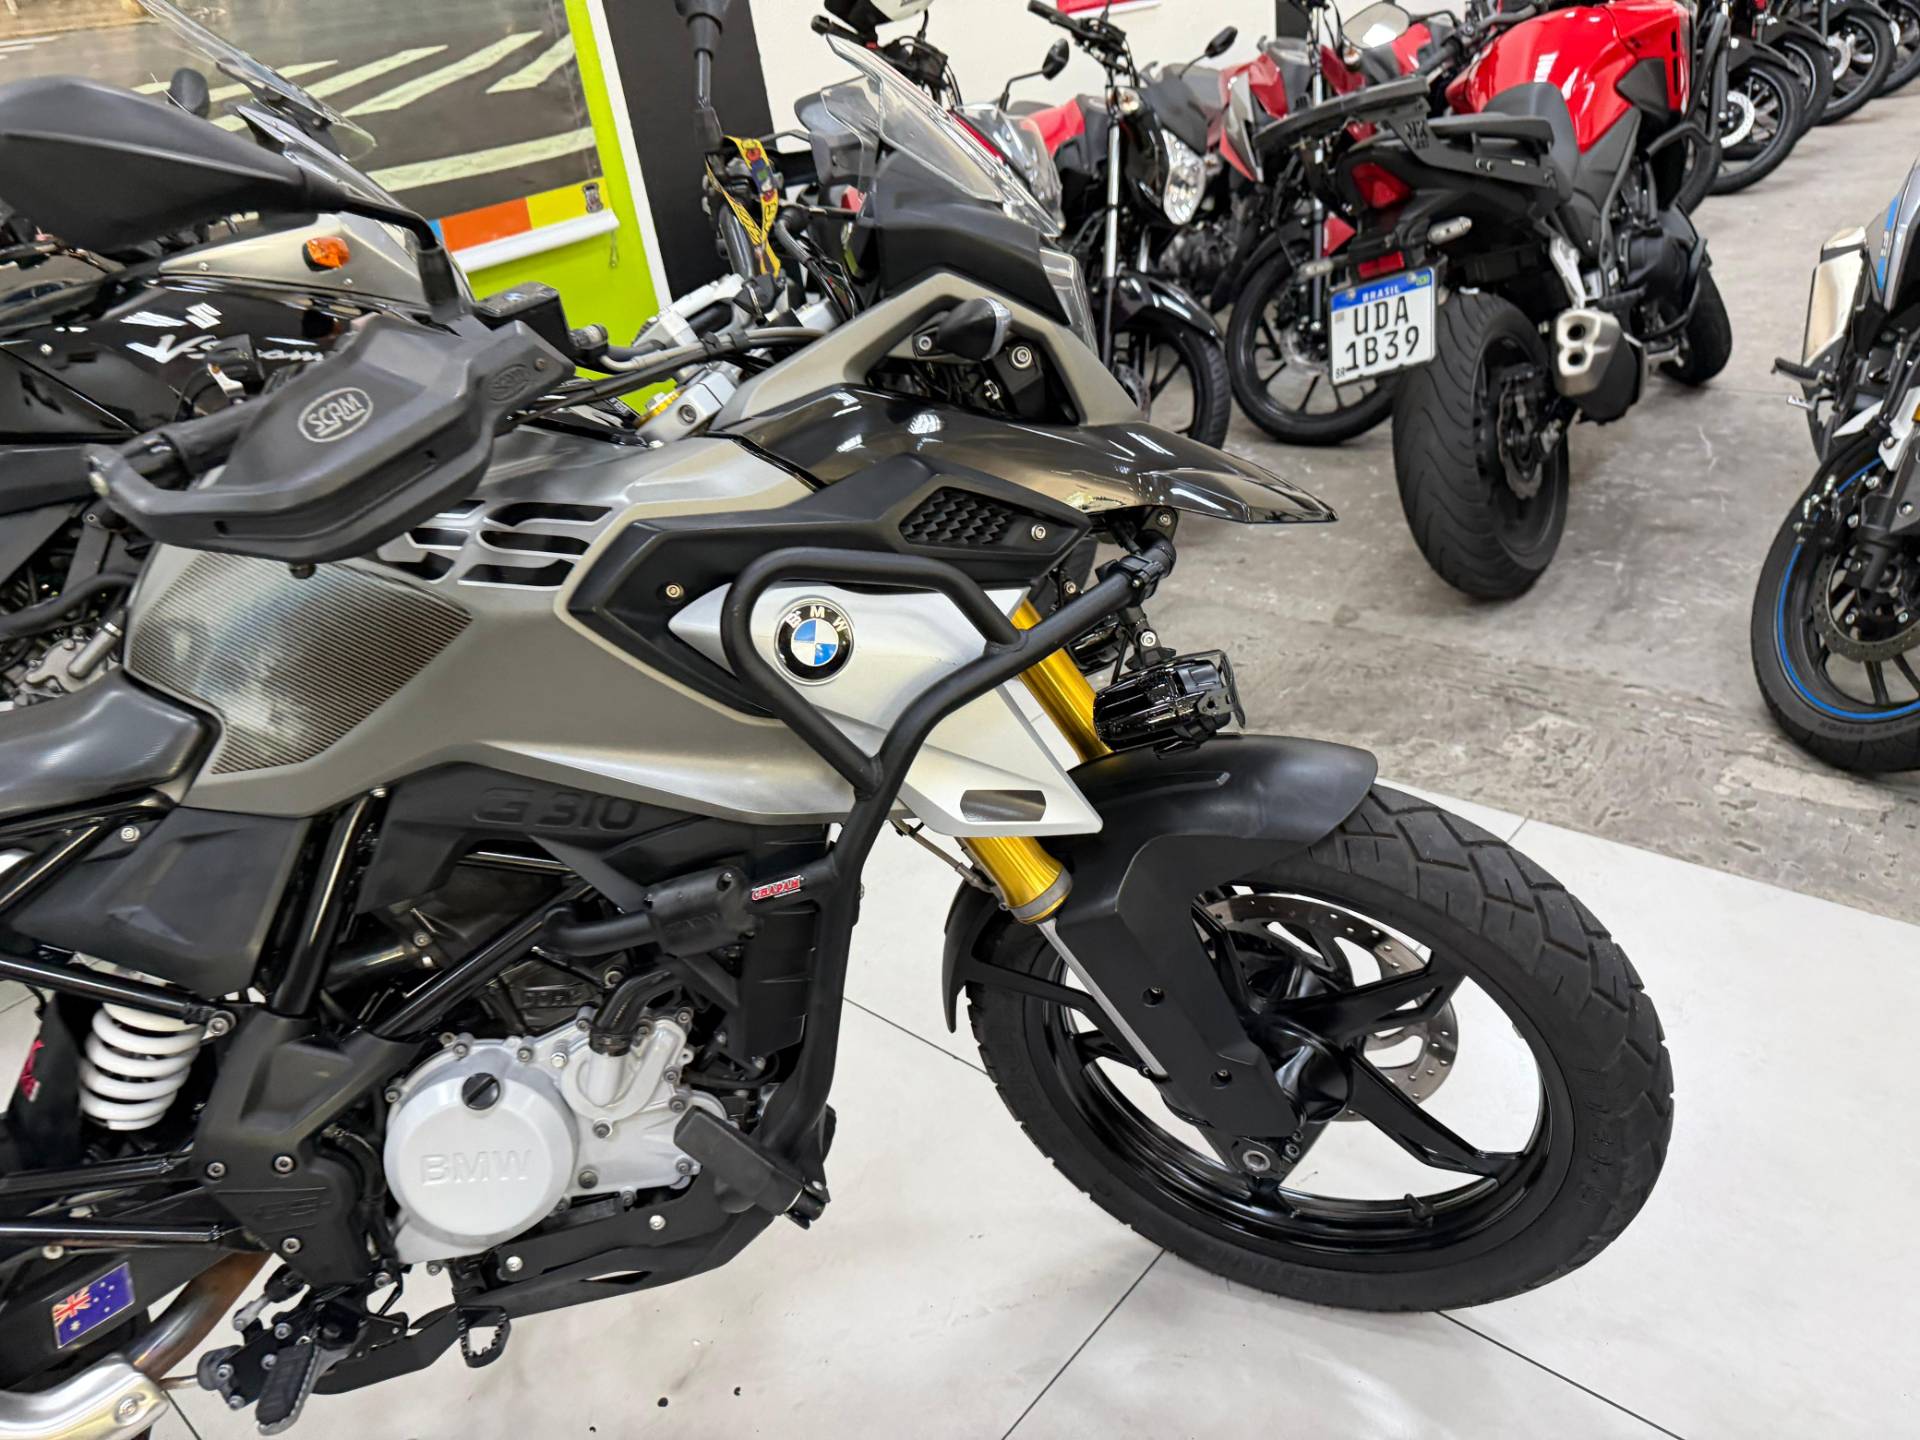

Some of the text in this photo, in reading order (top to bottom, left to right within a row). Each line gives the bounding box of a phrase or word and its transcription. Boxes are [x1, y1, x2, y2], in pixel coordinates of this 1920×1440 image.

[1361, 285, 1400, 303] BRASIL
[1354, 295, 1408, 336] UDA
[1345, 326, 1420, 371] 1B39
[307, 392, 367, 437] SCAM
[785, 604, 848, 633] BMW
[533, 790, 641, 833] 310
[420, 1149, 534, 1187] BMW
